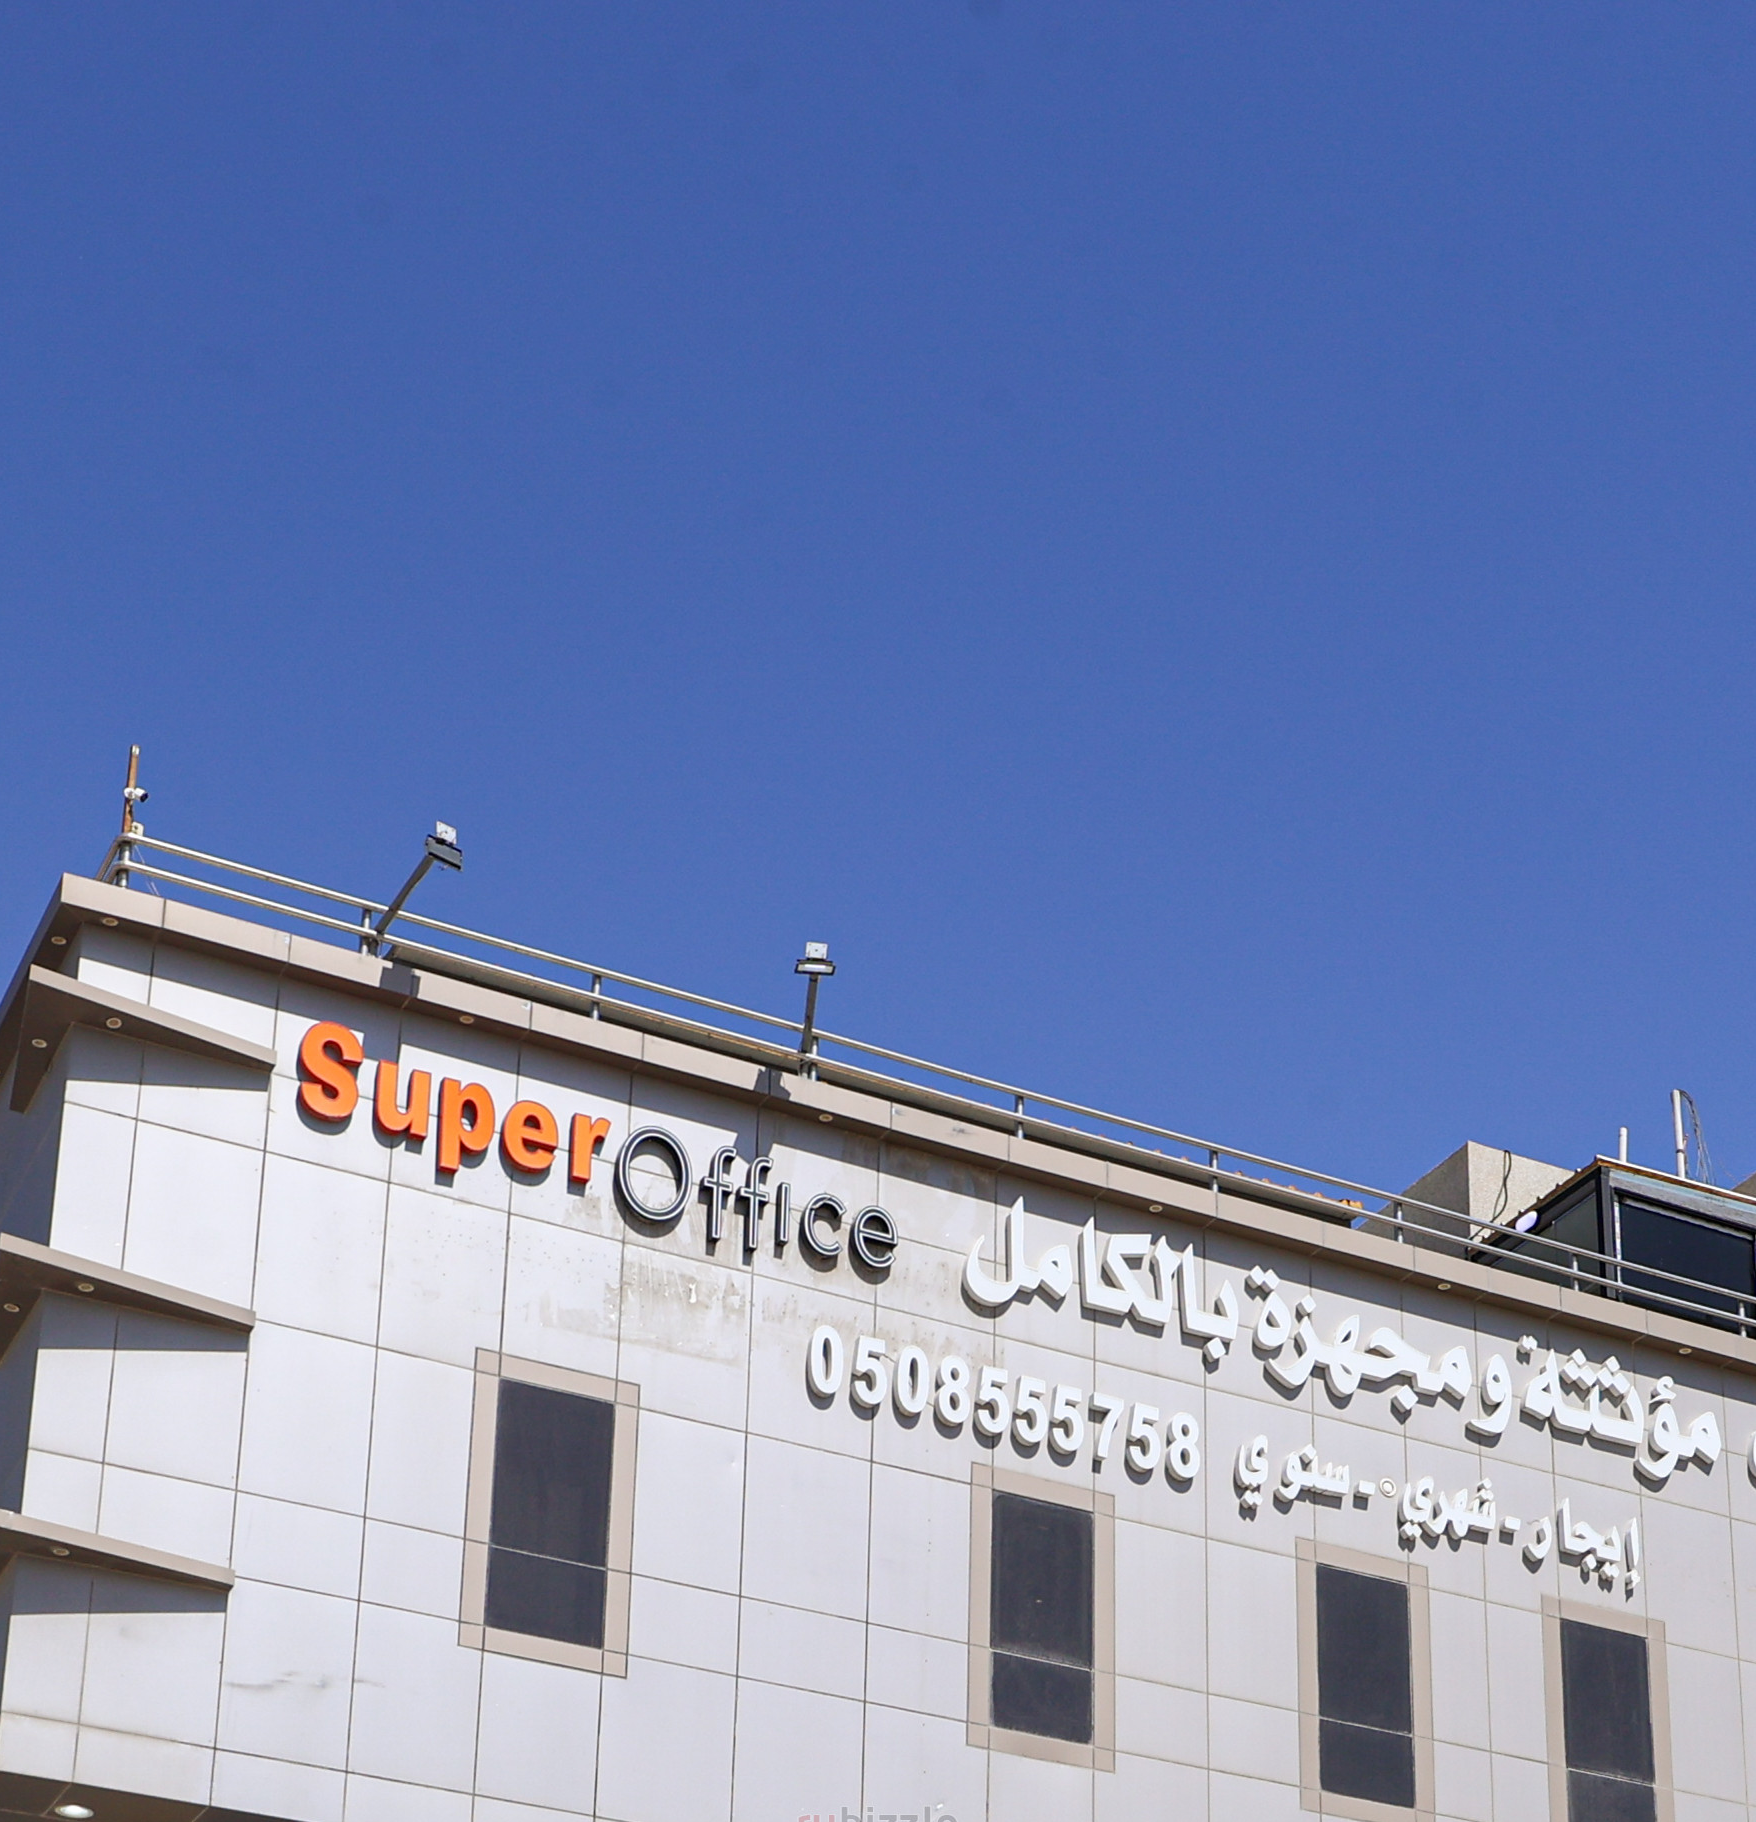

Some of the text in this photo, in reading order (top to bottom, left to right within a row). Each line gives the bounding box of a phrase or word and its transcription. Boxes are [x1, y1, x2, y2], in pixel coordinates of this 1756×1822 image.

[298, 1020, 899, 1269] Super Office
[963, 1194, 1239, 1362] بالكامل
[807, 1325, 1201, 1482] 0508555758
